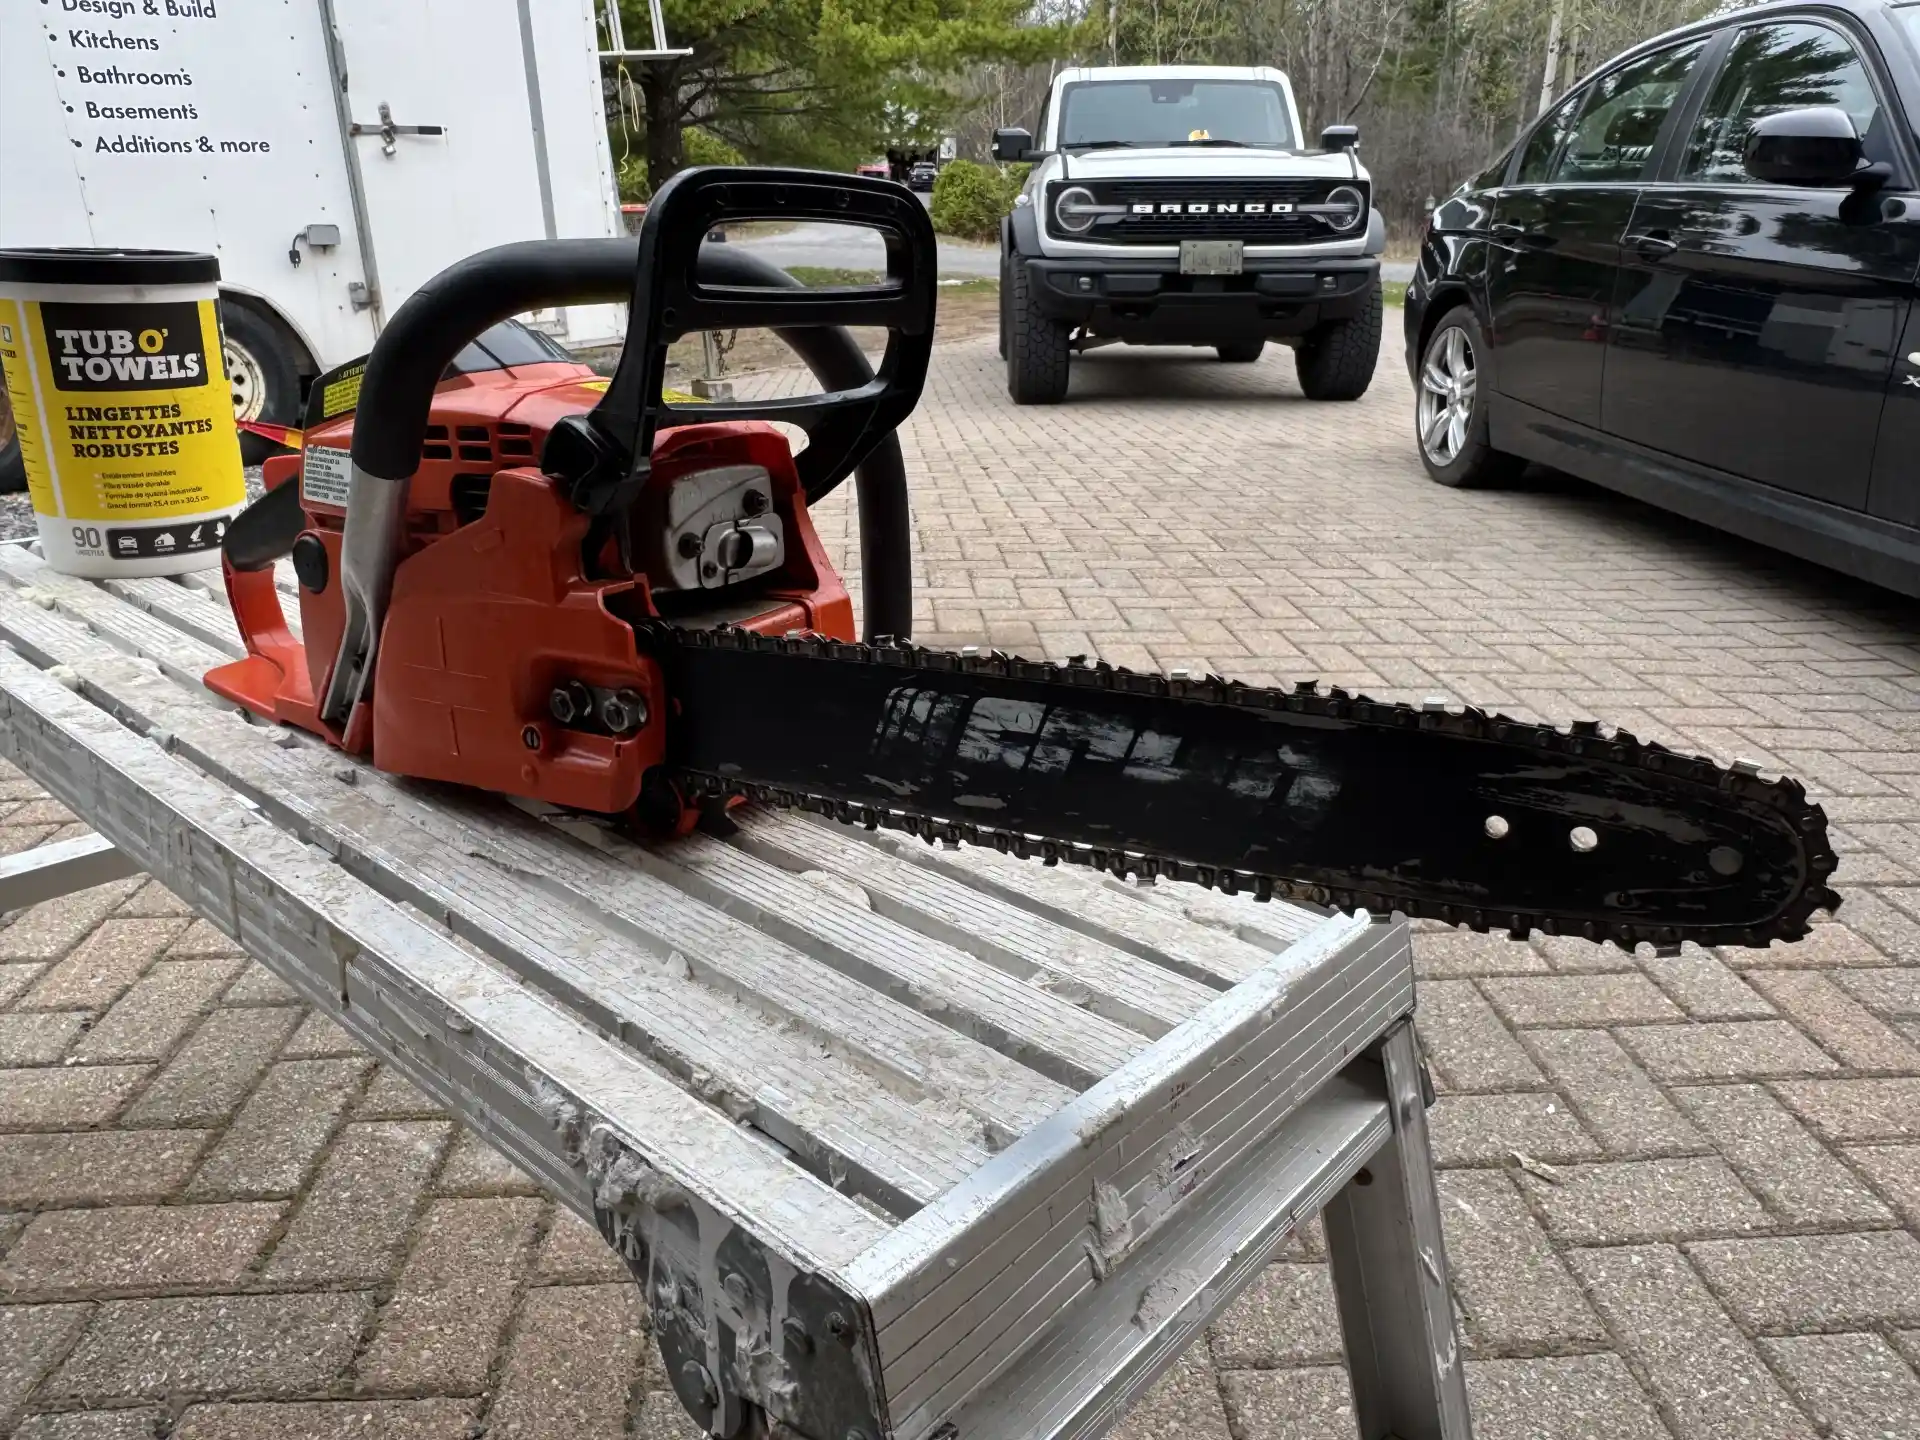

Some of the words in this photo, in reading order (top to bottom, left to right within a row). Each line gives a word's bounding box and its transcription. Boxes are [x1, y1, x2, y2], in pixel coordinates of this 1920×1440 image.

[62, 0, 136, 19] Design
[143, 0, 160, 16] &
[166, 0, 217, 19] Build
[69, 30, 159, 51] Kitchens
[77, 66, 193, 86] Bathrooms
[86, 101, 198, 120] Basements
[95, 135, 193, 153] Additions
[199, 136, 215, 153] &
[220, 140, 271, 153] more
[1132, 204, 1293, 213] BRONCO
[56, 330, 135, 355] TUB
[61, 353, 200, 382] TOWELS
[64, 403, 181, 422] LINGETTES
[69, 418, 213, 440] NETTOYANTES
[72, 440, 180, 458] ROBUSTES
[72, 526, 101, 549] 90
